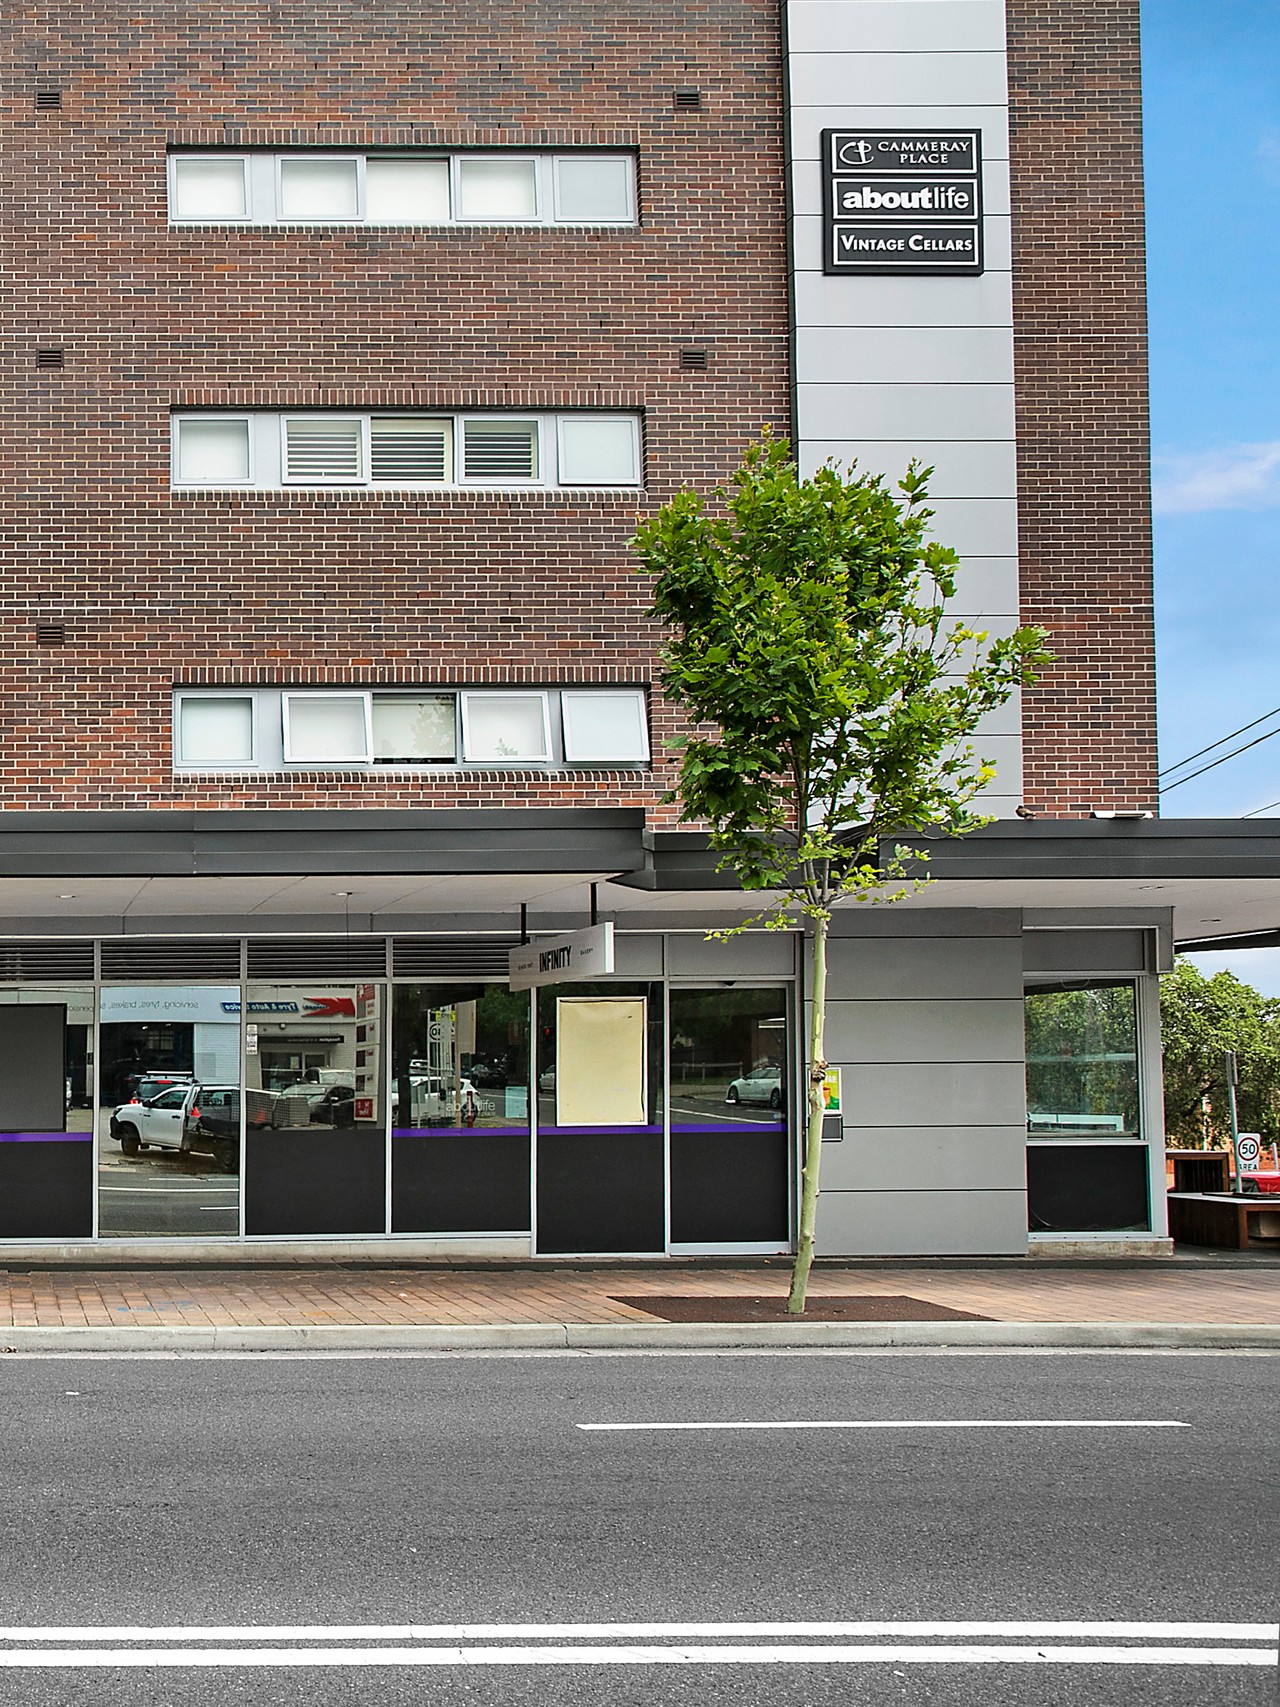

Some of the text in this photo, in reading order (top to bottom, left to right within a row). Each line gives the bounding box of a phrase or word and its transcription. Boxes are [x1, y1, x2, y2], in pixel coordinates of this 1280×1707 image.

[877, 141, 970, 152] CAMMERAY
[899, 153, 949, 164] PLACE
[842, 186, 970, 209] aboutlife
[840, 234, 973, 251] VINTAGE CELLARS
[539, 945, 572, 973] INFINITY
[1242, 1143, 1256, 1155] 50
